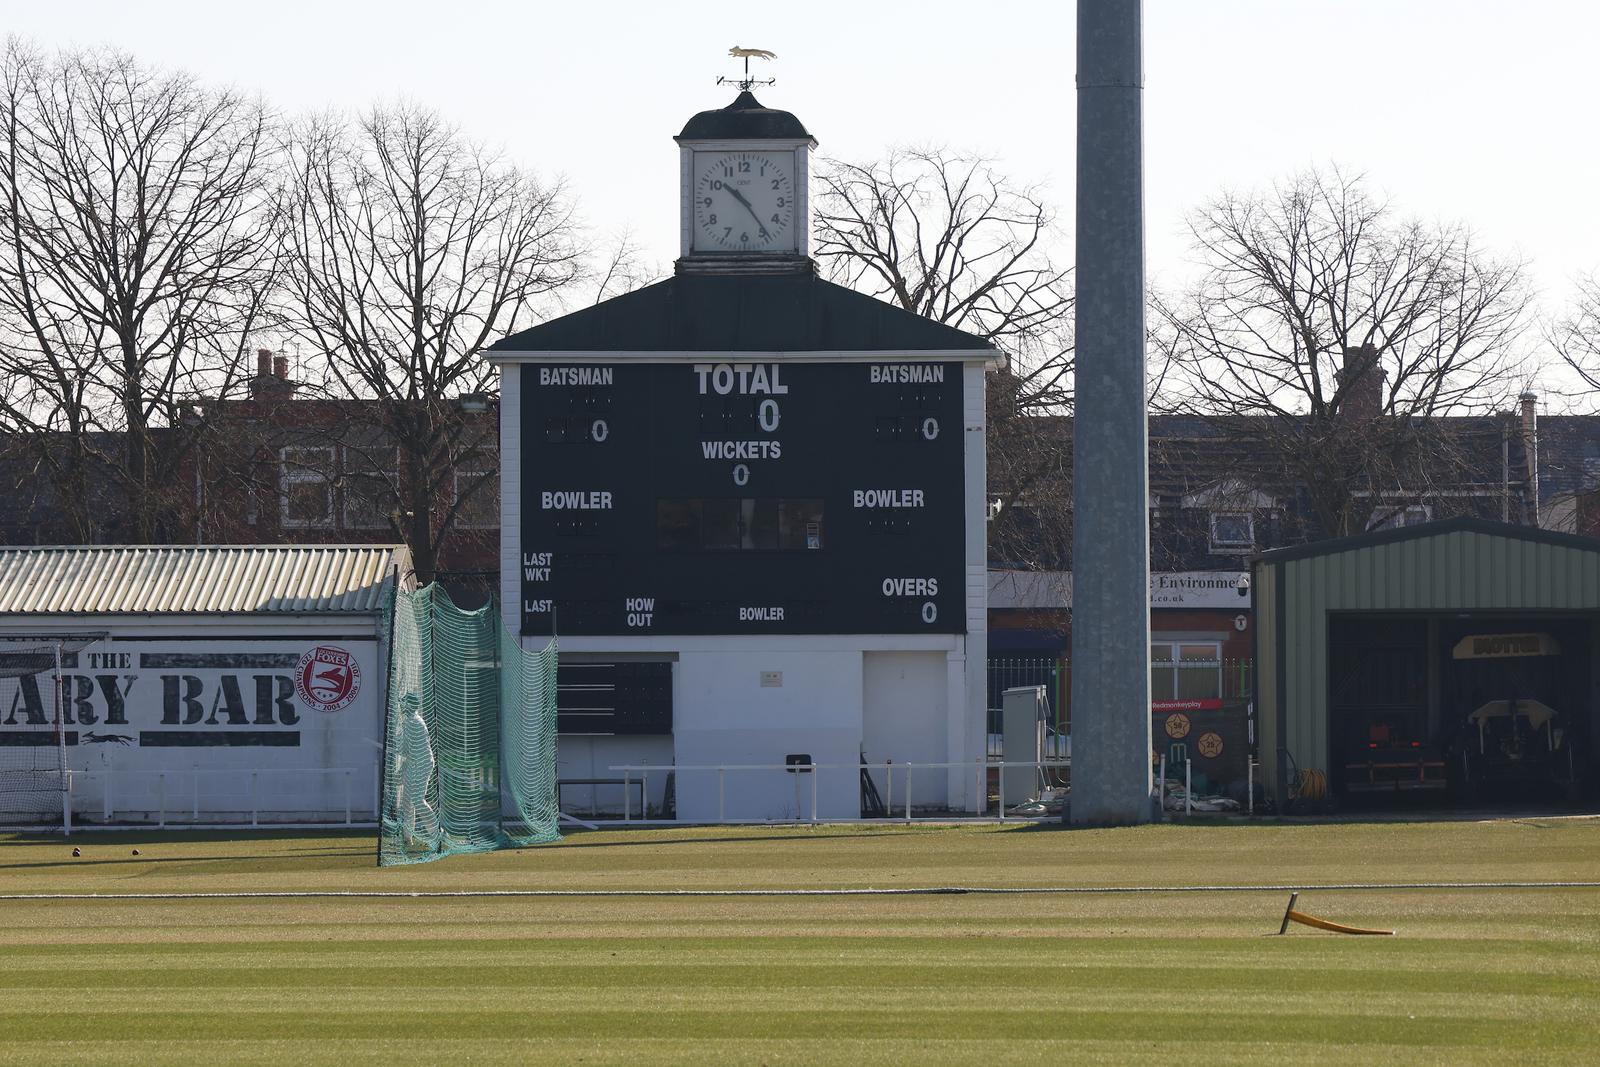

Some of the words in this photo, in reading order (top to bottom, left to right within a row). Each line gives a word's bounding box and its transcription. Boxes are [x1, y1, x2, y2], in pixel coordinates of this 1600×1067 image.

[724, 166, 733, 177] 11
[738, 162, 751, 173] 12
[760, 166, 764, 176] 1
[710, 180, 722, 190] 10
[771, 180, 780, 190] 2
[704, 197, 712, 208] 9
[776, 197, 785, 208] 3
[709, 214, 717, 224] 8
[771, 213, 780, 224] 4
[723, 227, 732, 238] 7
[740, 232, 749, 242] 6
[758, 227, 767, 238] 5
[540, 368, 613, 385] BATSMAN
[694, 364, 789, 395] TOTAL
[870, 365, 944, 383] BATSMAN
[758, 399, 780, 432] 0
[592, 419, 608, 442] 0
[922, 417, 939, 440] 0
[702, 441, 781, 459] WICKETS
[733, 464, 749, 486] 0
[541, 491, 613, 509] BOWLER
[853, 490, 925, 508] BOWLER
[523, 552, 552, 566] LAST
[525, 568, 551, 581] WKT
[1160, 575, 1244, 588] Environme
[882, 578, 938, 596] OVERS
[525, 600, 552, 613] LAST
[626, 598, 655, 612] HOW
[627, 613, 653, 627] OUT
[739, 607, 785, 620] BOWLER
[922, 602, 937, 624] 0
[87, 652, 131, 669] THE
[316, 653, 346, 664] FOXES
[350, 662, 360, 679] 2011
[296, 666, 316, 708] CHAMPIONS
[0, 674, 138, 725] ARY
[159, 674, 301, 725] BAR
[346, 686, 359, 703] 2006
